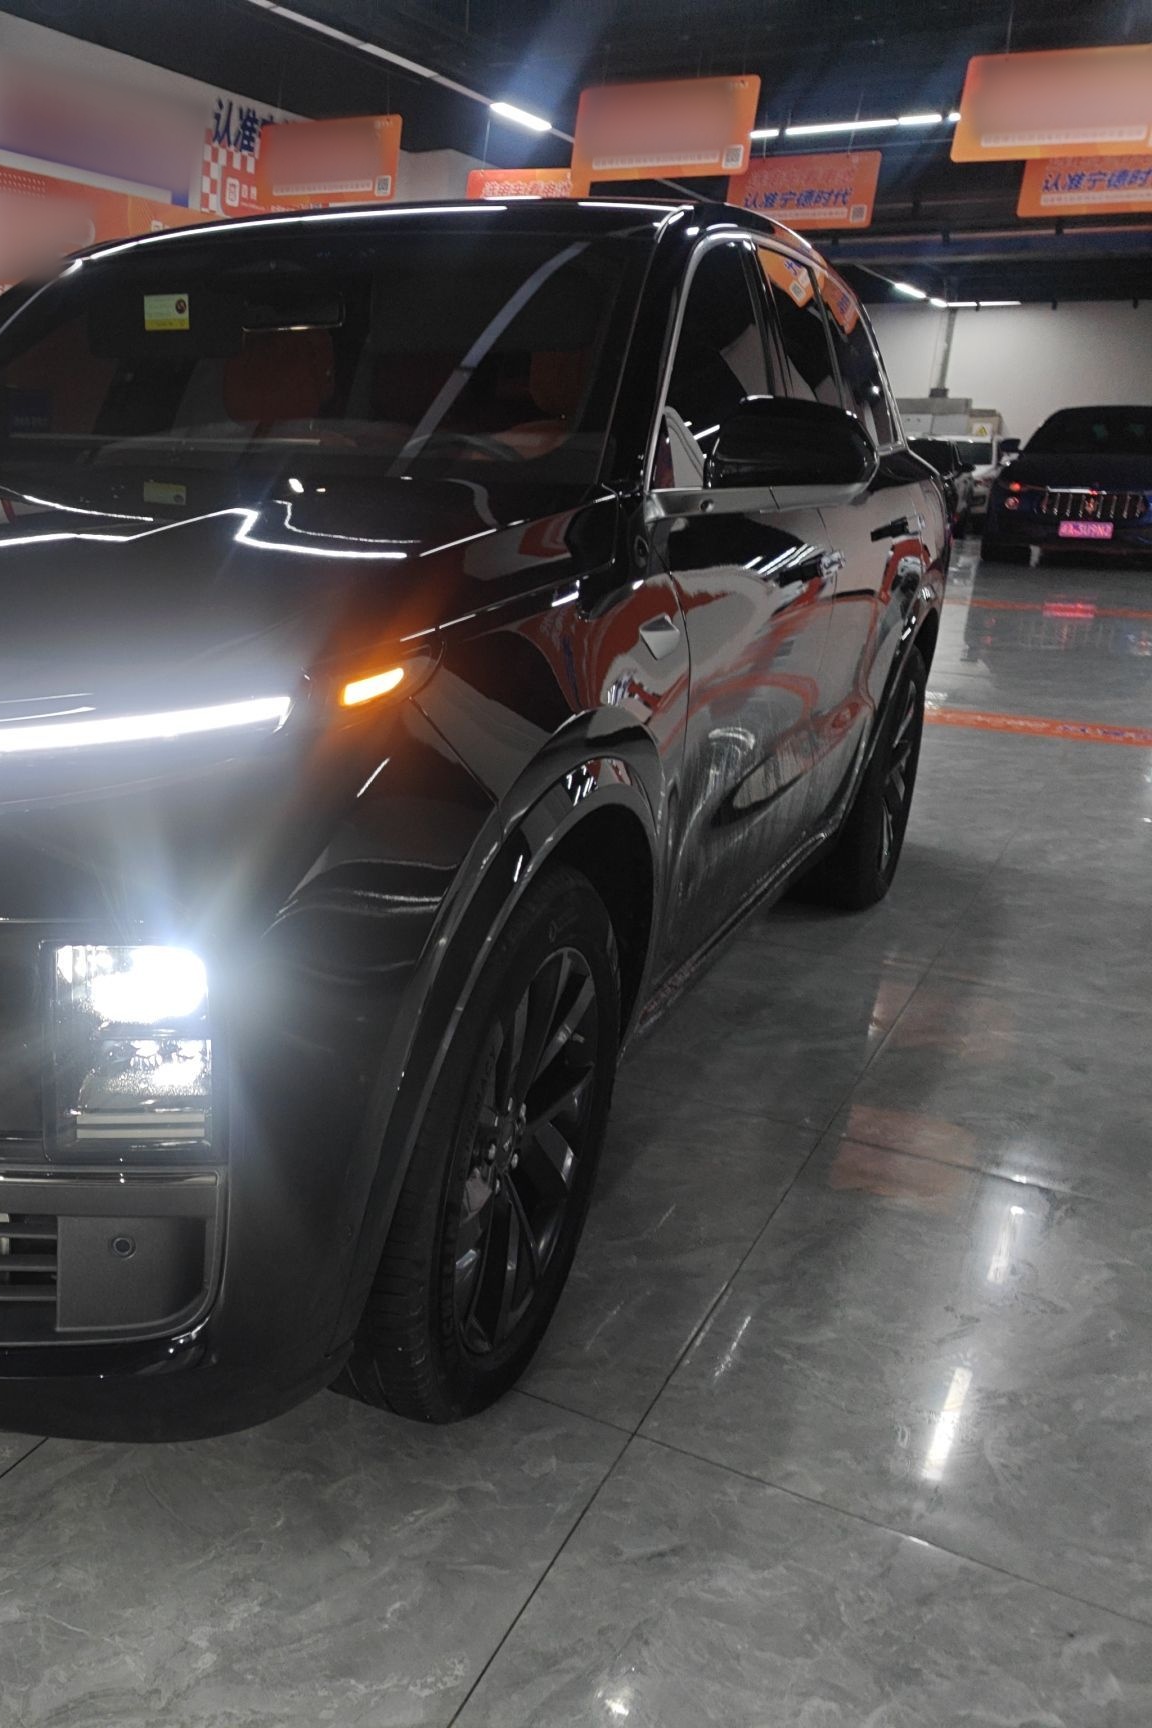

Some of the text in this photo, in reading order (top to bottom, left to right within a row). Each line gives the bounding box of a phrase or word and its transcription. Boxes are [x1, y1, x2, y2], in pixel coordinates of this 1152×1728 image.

[743, 187, 853, 210] 认准宁德时代
